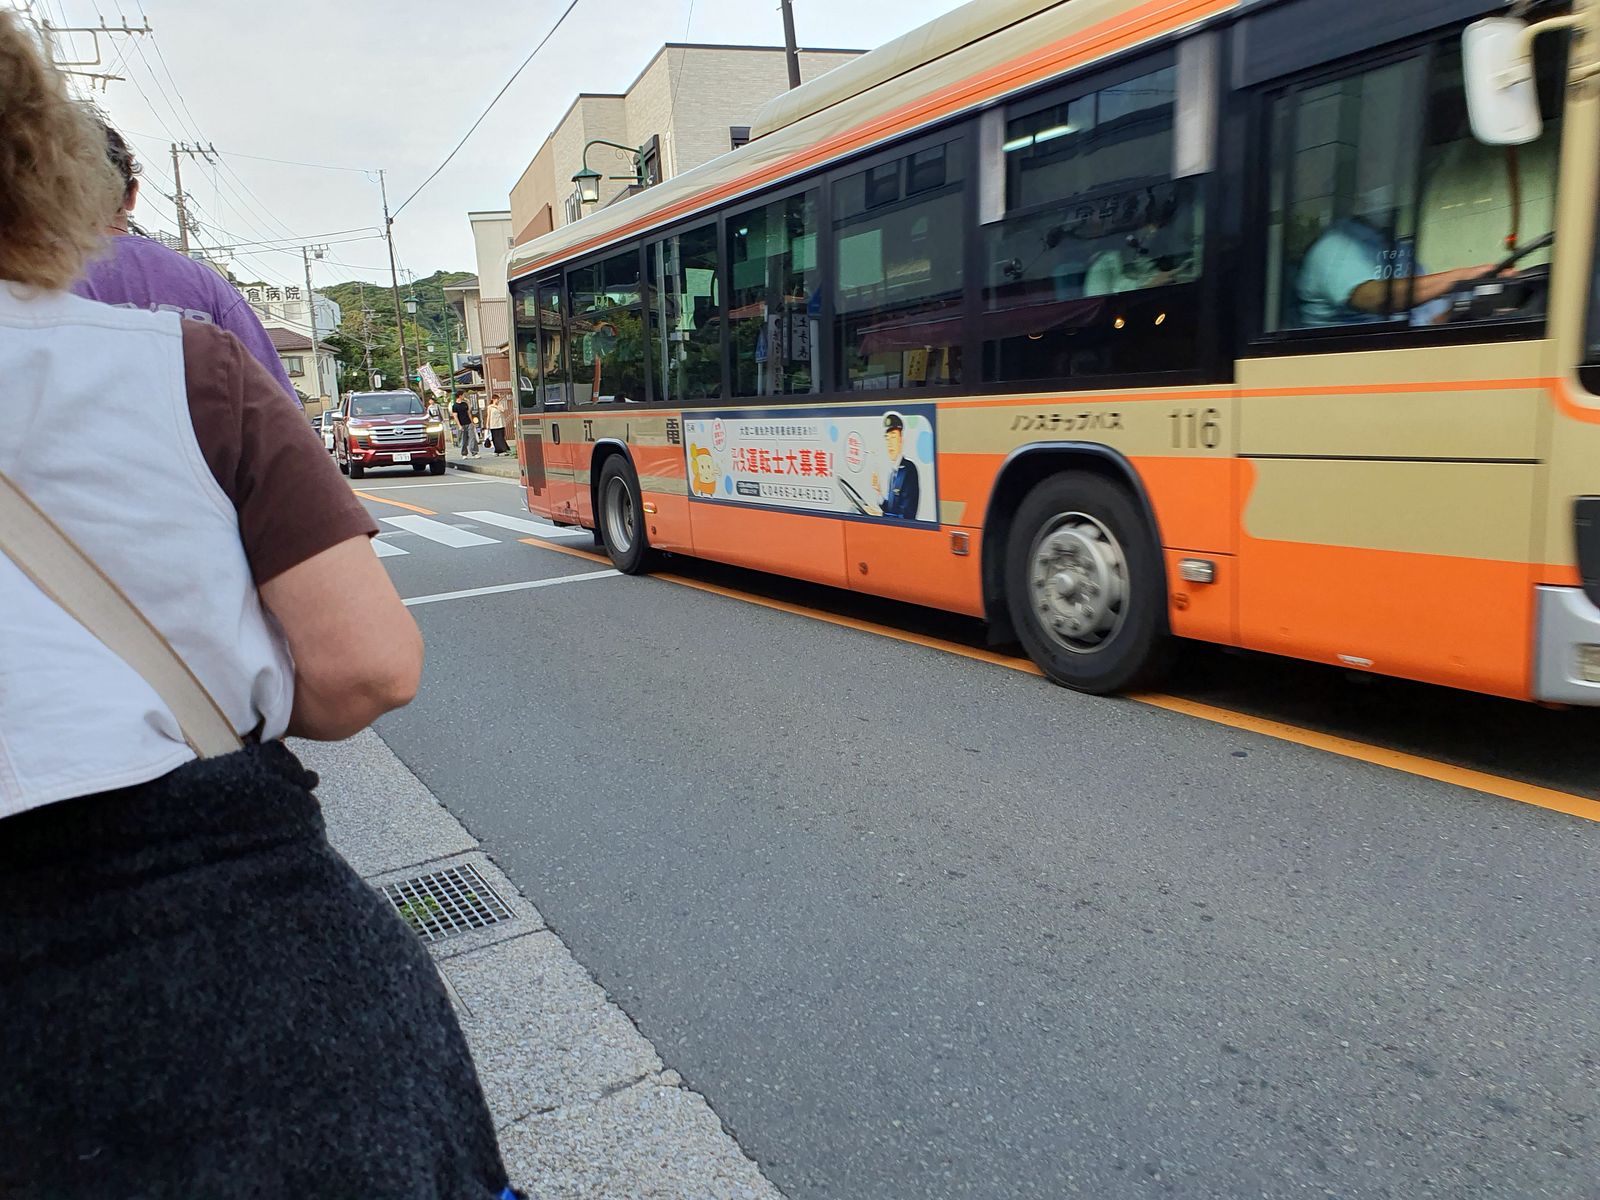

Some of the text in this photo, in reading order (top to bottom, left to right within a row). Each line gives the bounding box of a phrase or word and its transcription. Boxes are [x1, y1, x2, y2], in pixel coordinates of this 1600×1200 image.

[246, 286, 301, 302] 倉病院
[1168, 408, 1221, 449] 116
